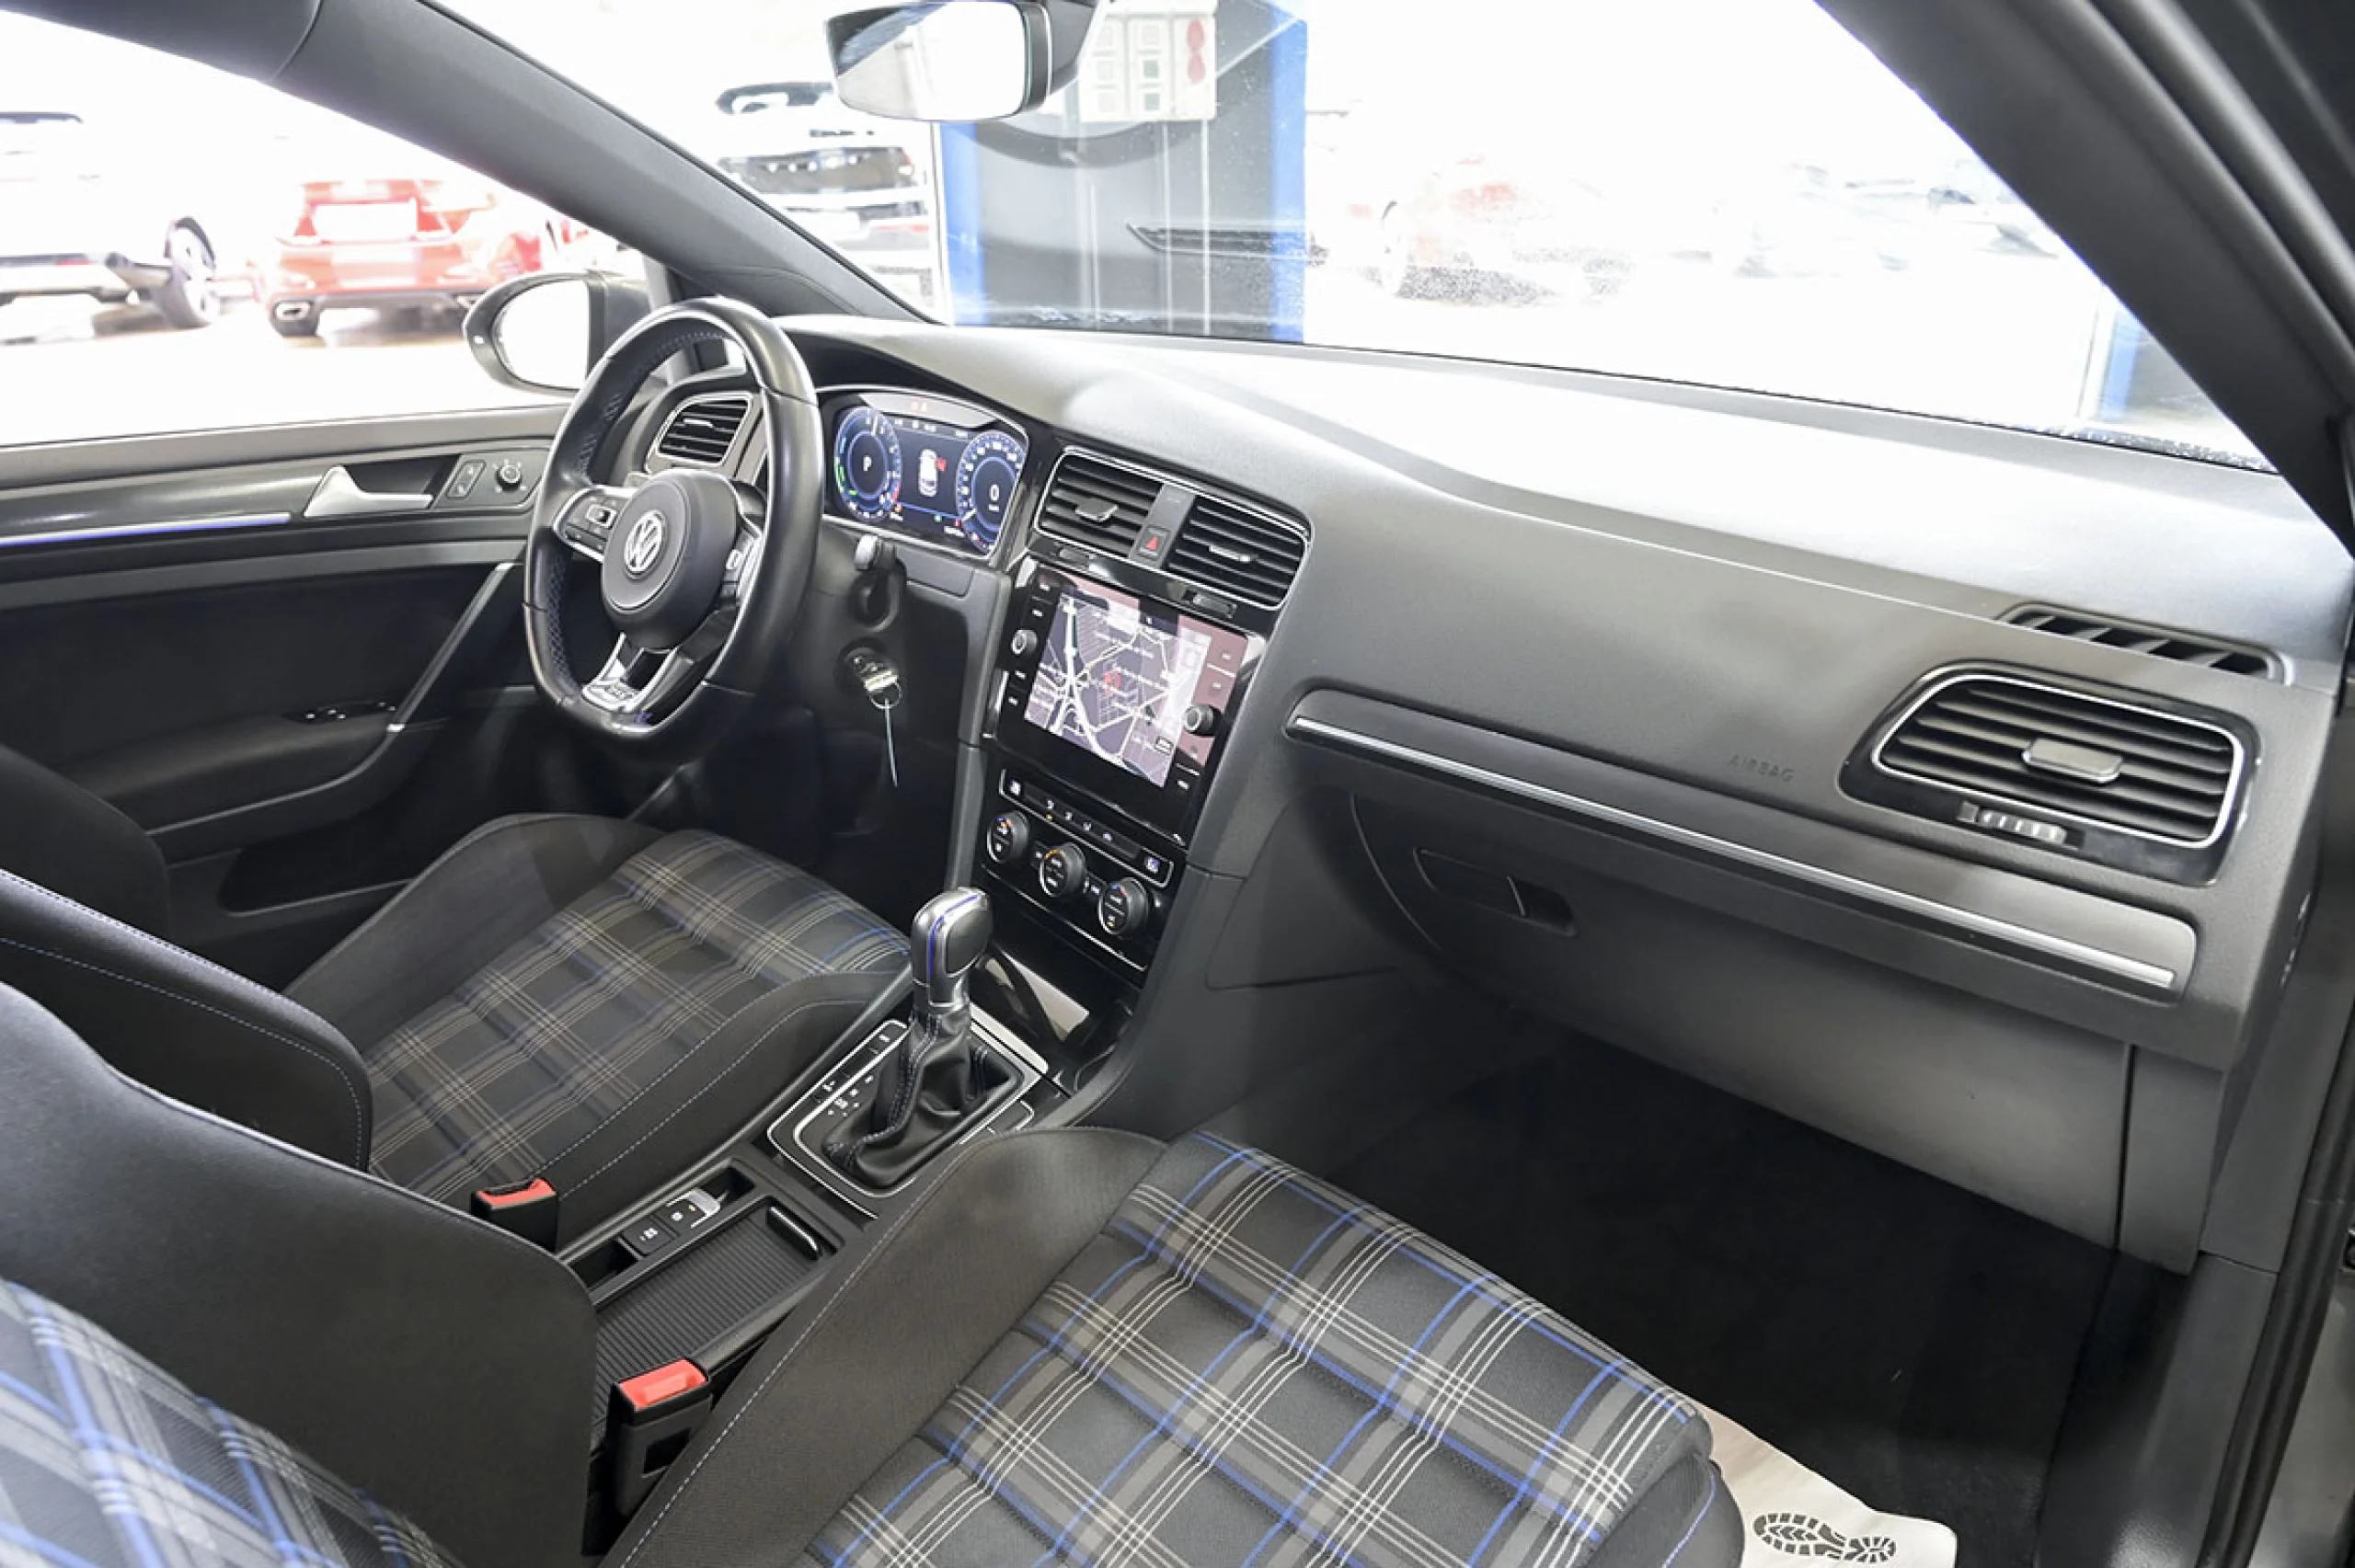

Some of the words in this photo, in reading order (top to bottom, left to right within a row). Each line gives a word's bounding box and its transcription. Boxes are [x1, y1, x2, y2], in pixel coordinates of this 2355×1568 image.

[863, 456, 872, 471] P
[990, 485, 999, 500] 0
[1727, 754, 1793, 782] AIRBAG
